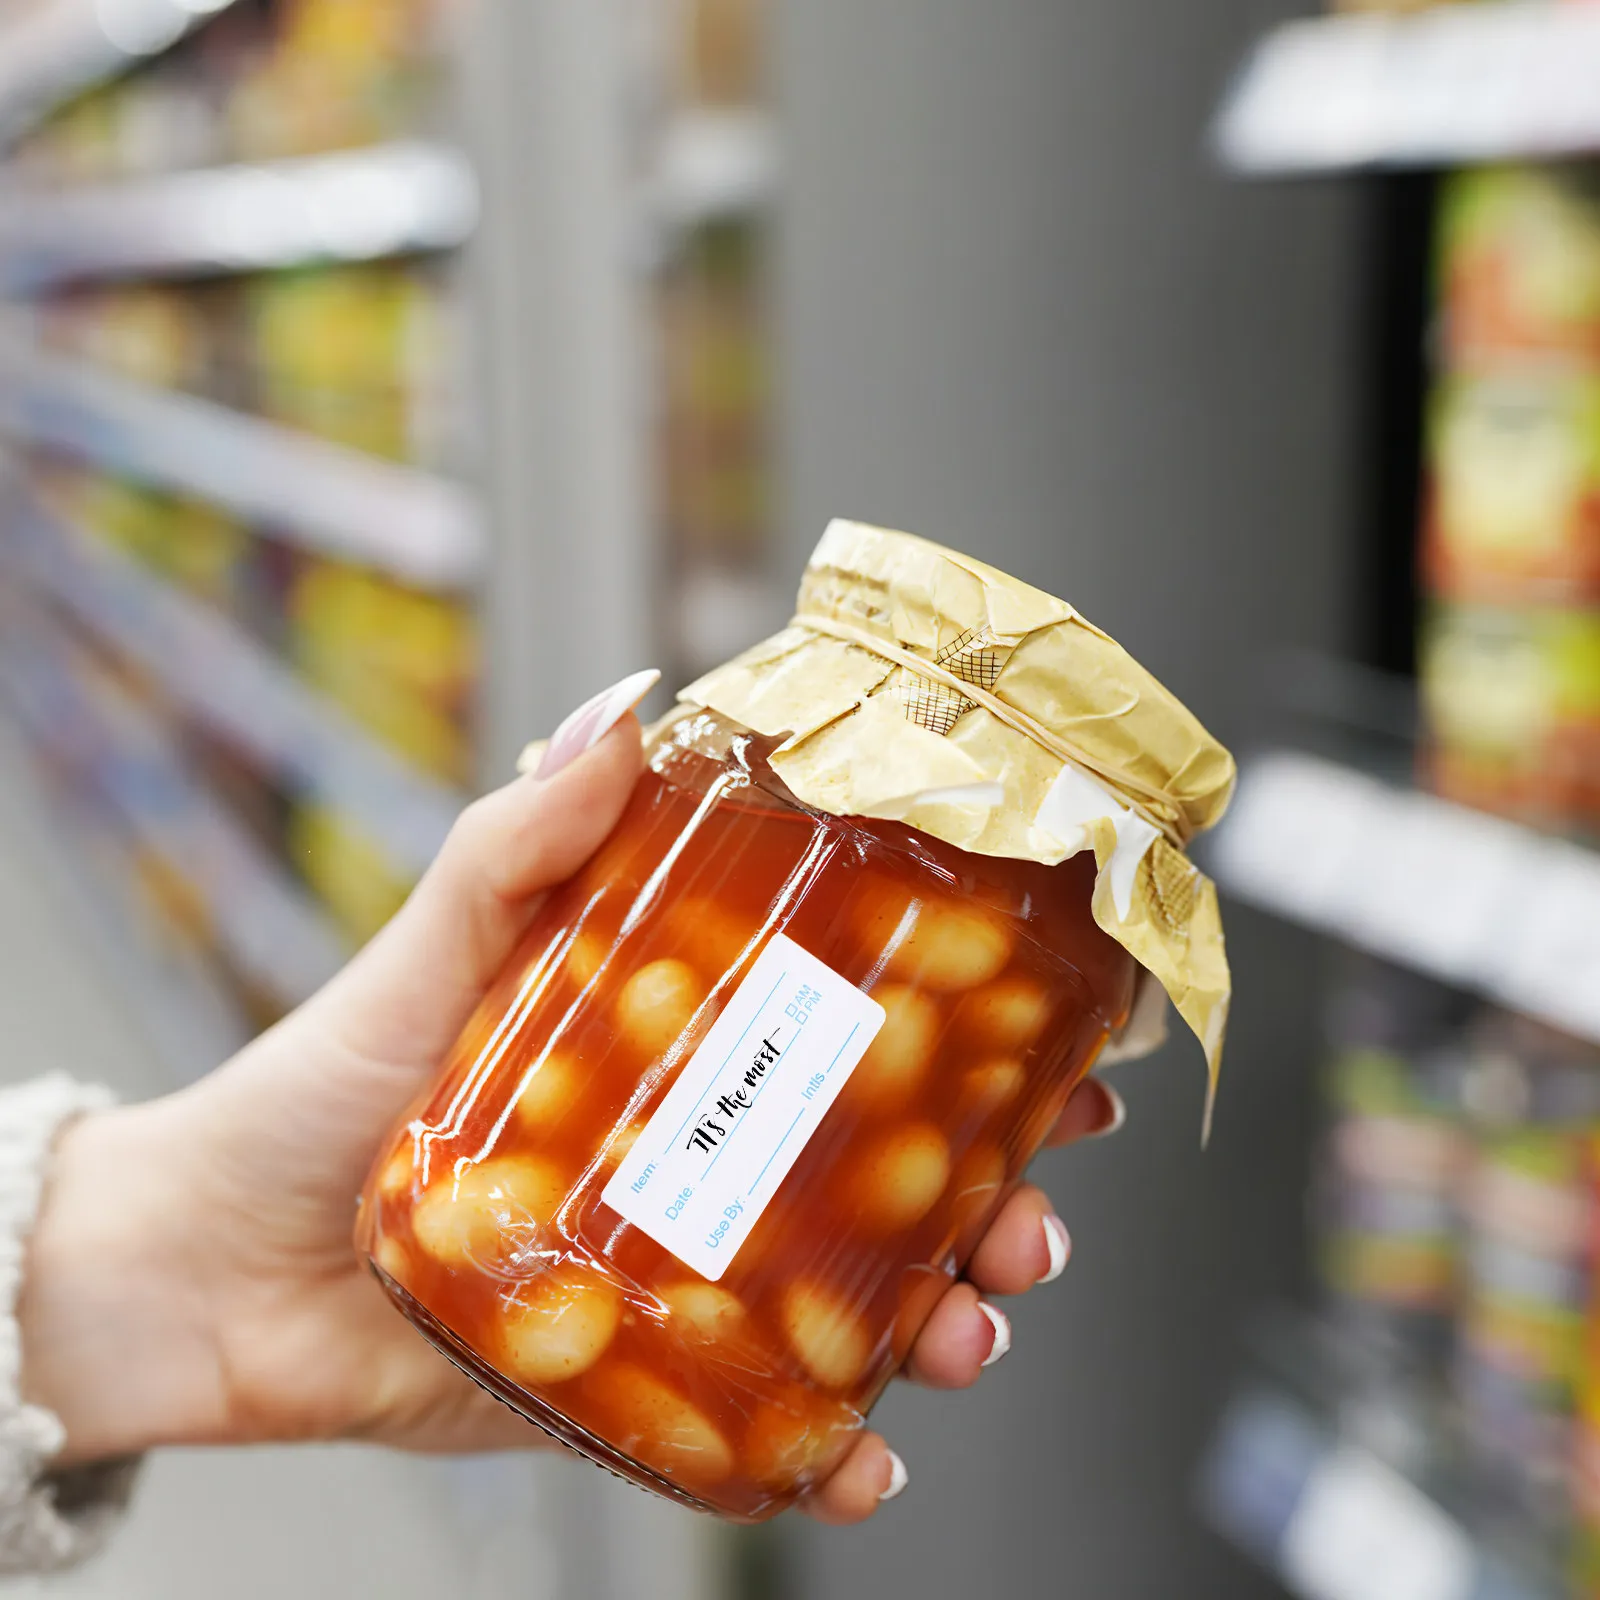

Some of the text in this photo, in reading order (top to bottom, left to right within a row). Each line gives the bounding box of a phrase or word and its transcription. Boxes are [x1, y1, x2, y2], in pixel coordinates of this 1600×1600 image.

[795, 984, 813, 1004] AM
[804, 991, 823, 1012] PM
[714, 1085, 753, 1118] the
[744, 1027, 781, 1088] most
[801, 1072, 826, 1101] Intls
[630, 1160, 660, 1193] Item:
[664, 1183, 696, 1221] Date:
[704, 1195, 746, 1249] Use By:
